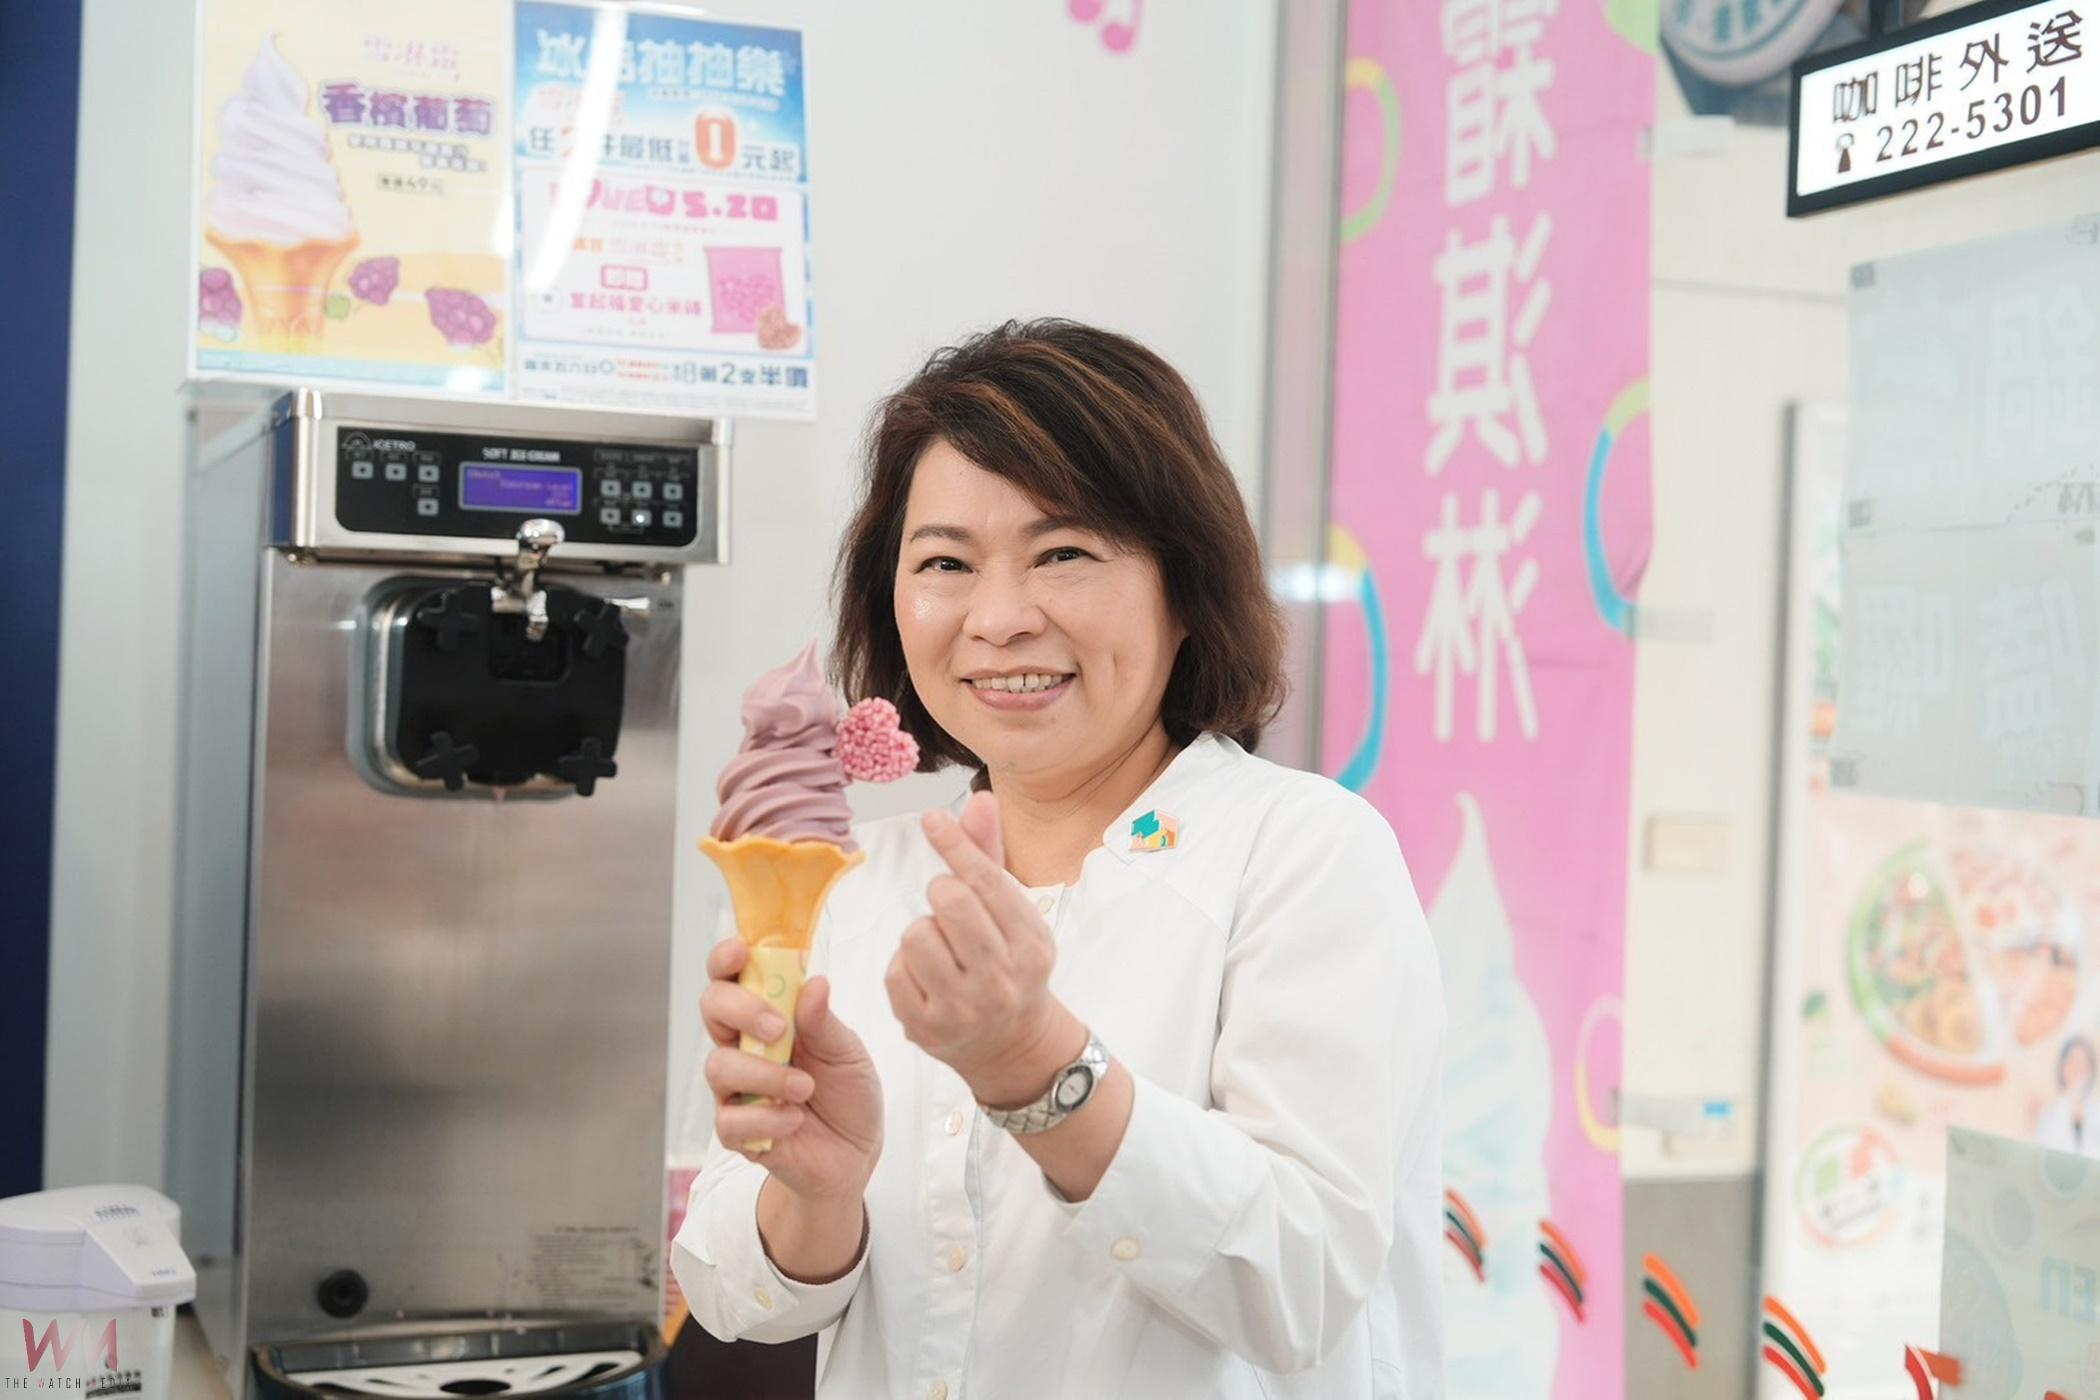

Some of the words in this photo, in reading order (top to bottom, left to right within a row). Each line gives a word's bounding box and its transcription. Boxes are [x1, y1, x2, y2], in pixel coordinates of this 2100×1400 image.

[1832, 9, 2084, 123] 咖啡外送
[1875, 75, 2069, 162] 222-5301
[373, 438, 416, 452] ICETRO
